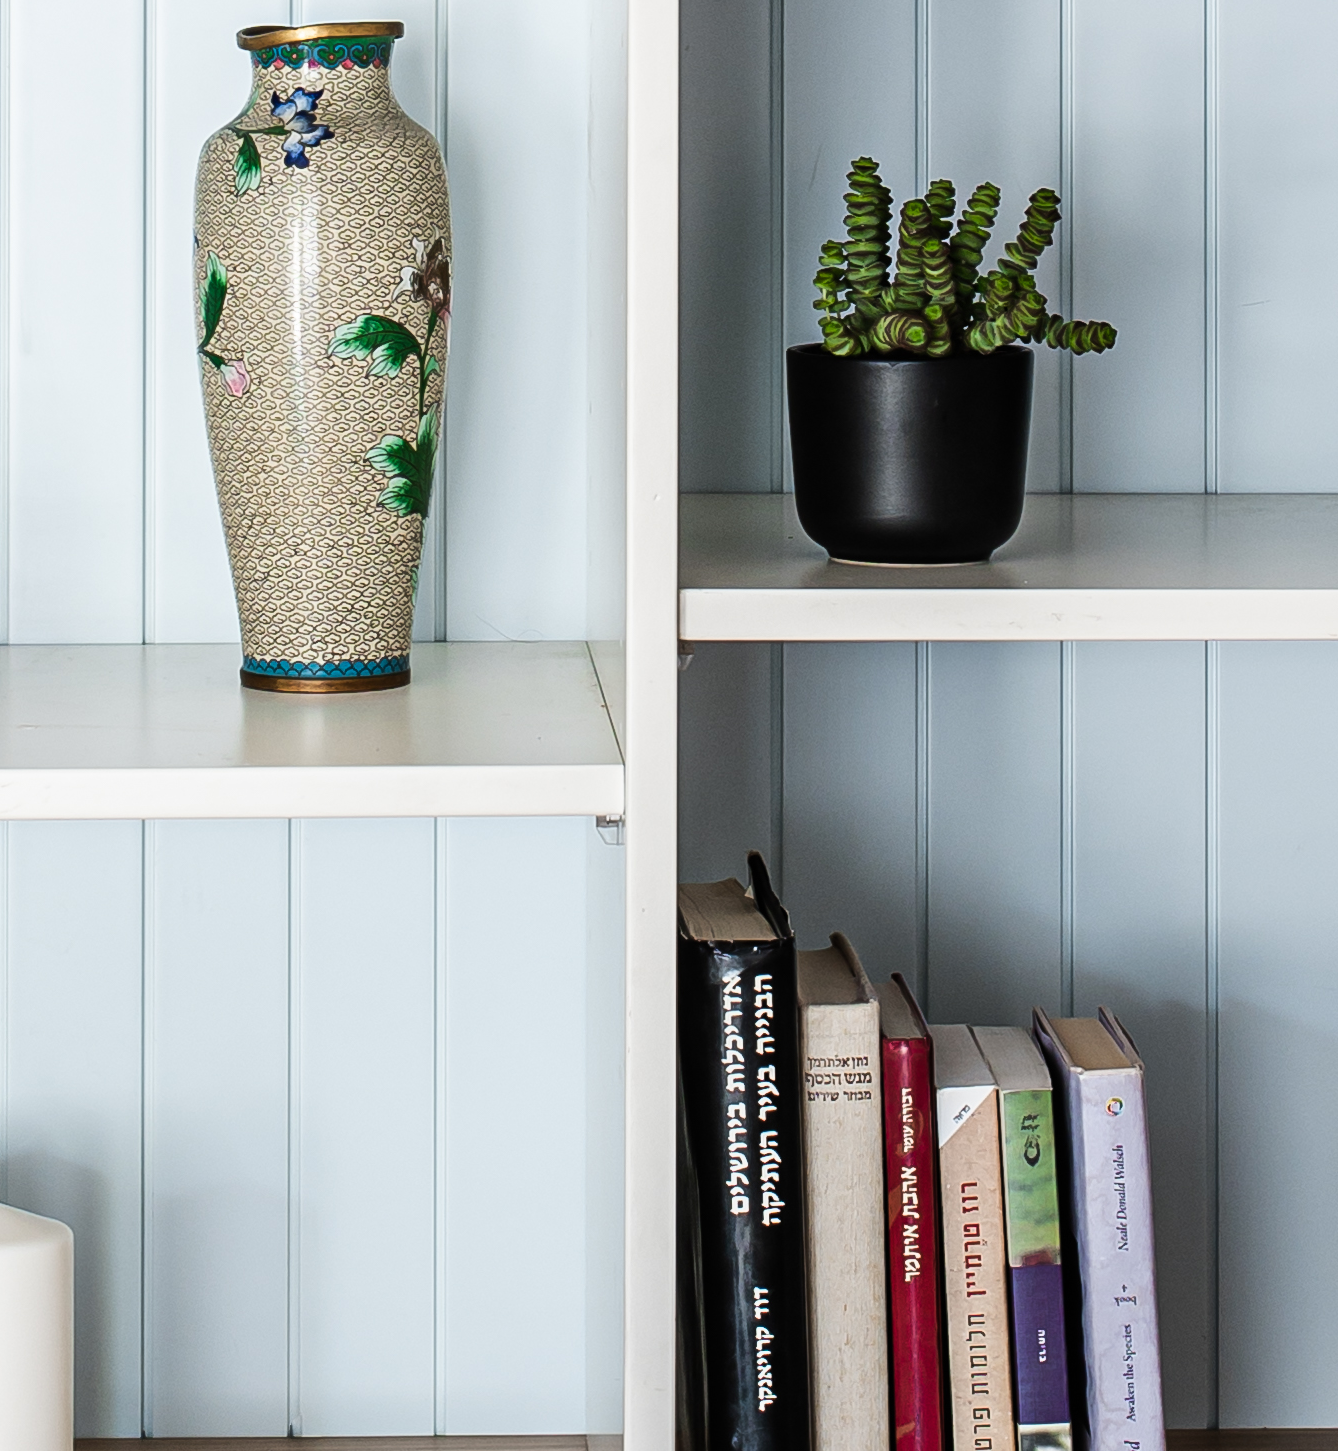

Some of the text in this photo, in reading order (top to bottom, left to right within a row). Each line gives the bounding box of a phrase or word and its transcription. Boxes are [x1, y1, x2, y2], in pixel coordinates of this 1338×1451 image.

[720, 975, 750, 1215] אדריכלות בירושלים
[804, 1071, 872, 1088] מגש הכסף
[807, 1054, 869, 1071] נתן אלתרמן
[752, 974, 786, 1227] הבנייה בעיר העתיקה
[807, 1090, 872, 1102] מבחר שירים
[900, 1087, 915, 1153] דבורה עומר
[900, 1167, 921, 1282] אהבת איתמר
[1112, 1144, 1129, 1252] Neale Donald Walsch
[752, 1286, 777, 1412] דוד קרויאנקר
[965, 1313, 991, 1395] חלומות
[1122, 1323, 1136, 1362] Species
[1123, 1363, 1135, 1381] the
[1125, 1381, 1137, 1422] Awaken
